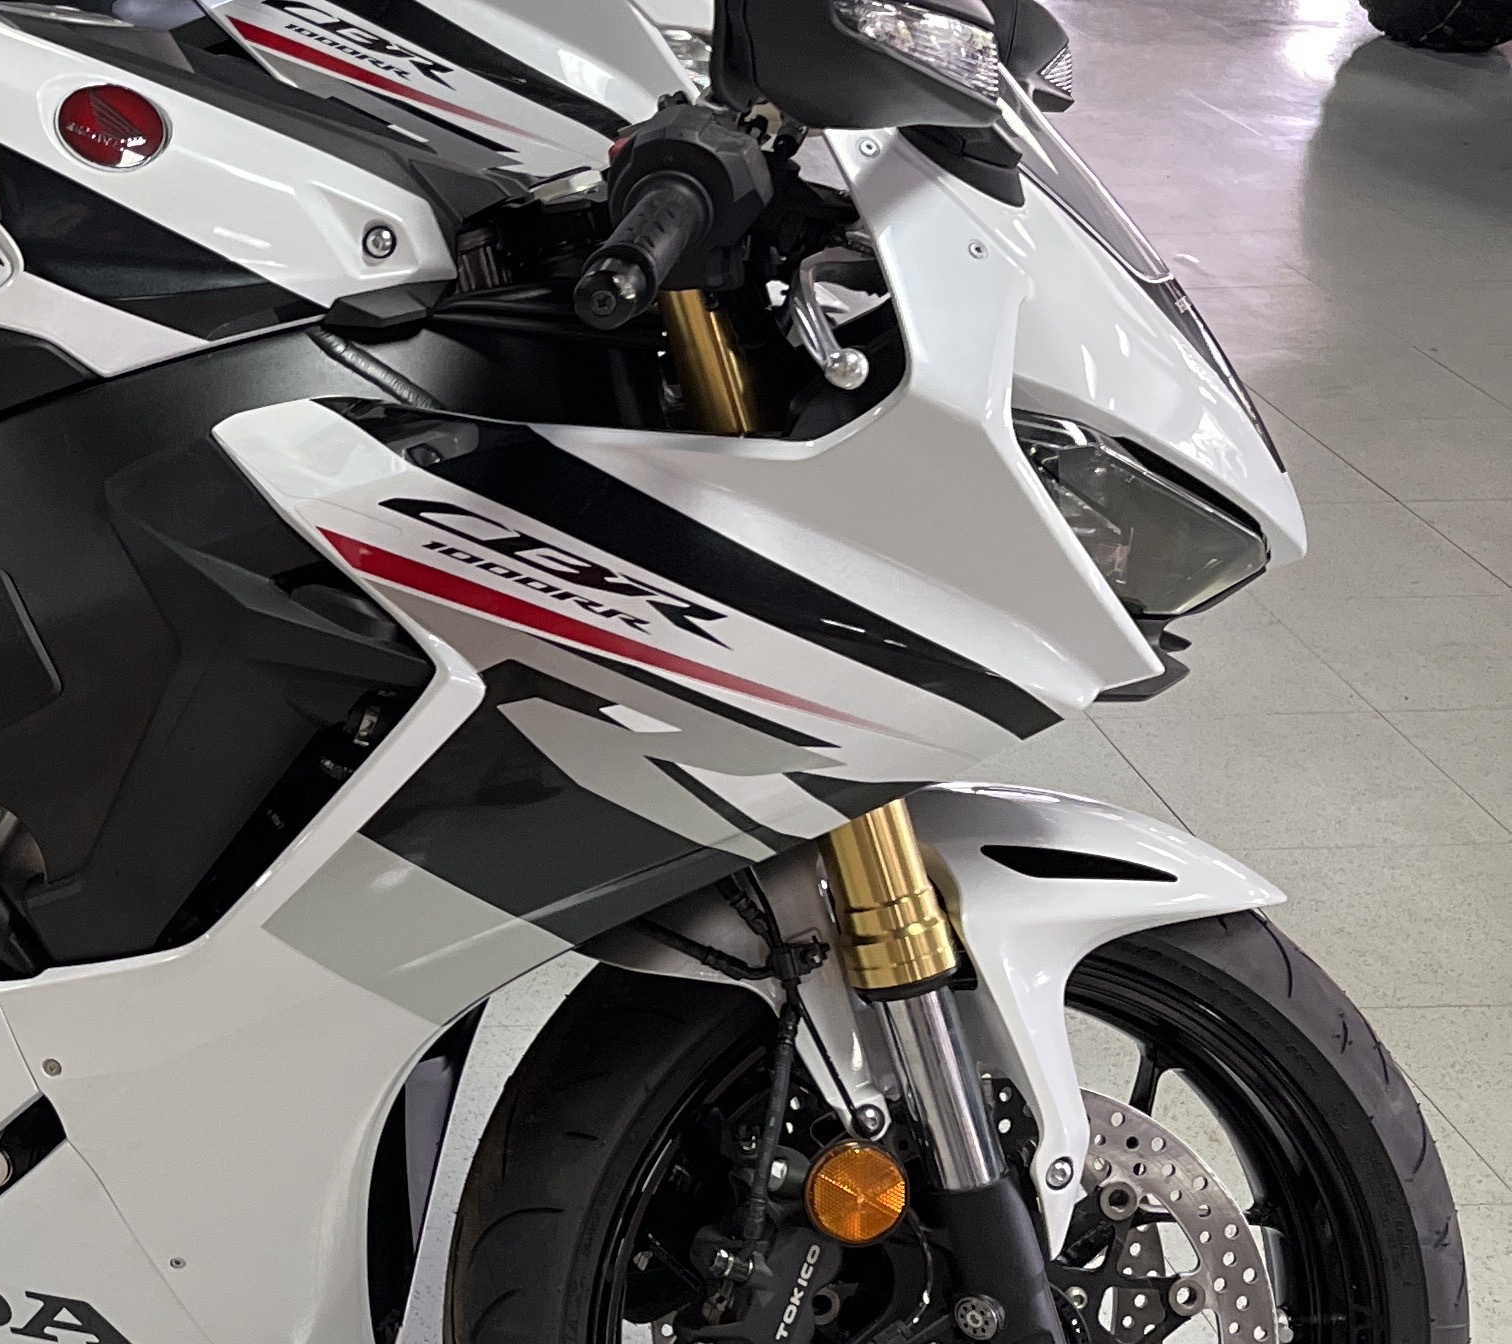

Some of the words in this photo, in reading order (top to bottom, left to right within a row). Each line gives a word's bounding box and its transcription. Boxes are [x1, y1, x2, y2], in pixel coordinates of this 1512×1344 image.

[285, 23, 410, 81] 1000RR
[378, 498, 733, 650] CBR
[422, 541, 652, 635] 1000RR
[775, 1244, 821, 1341] TOKICO
